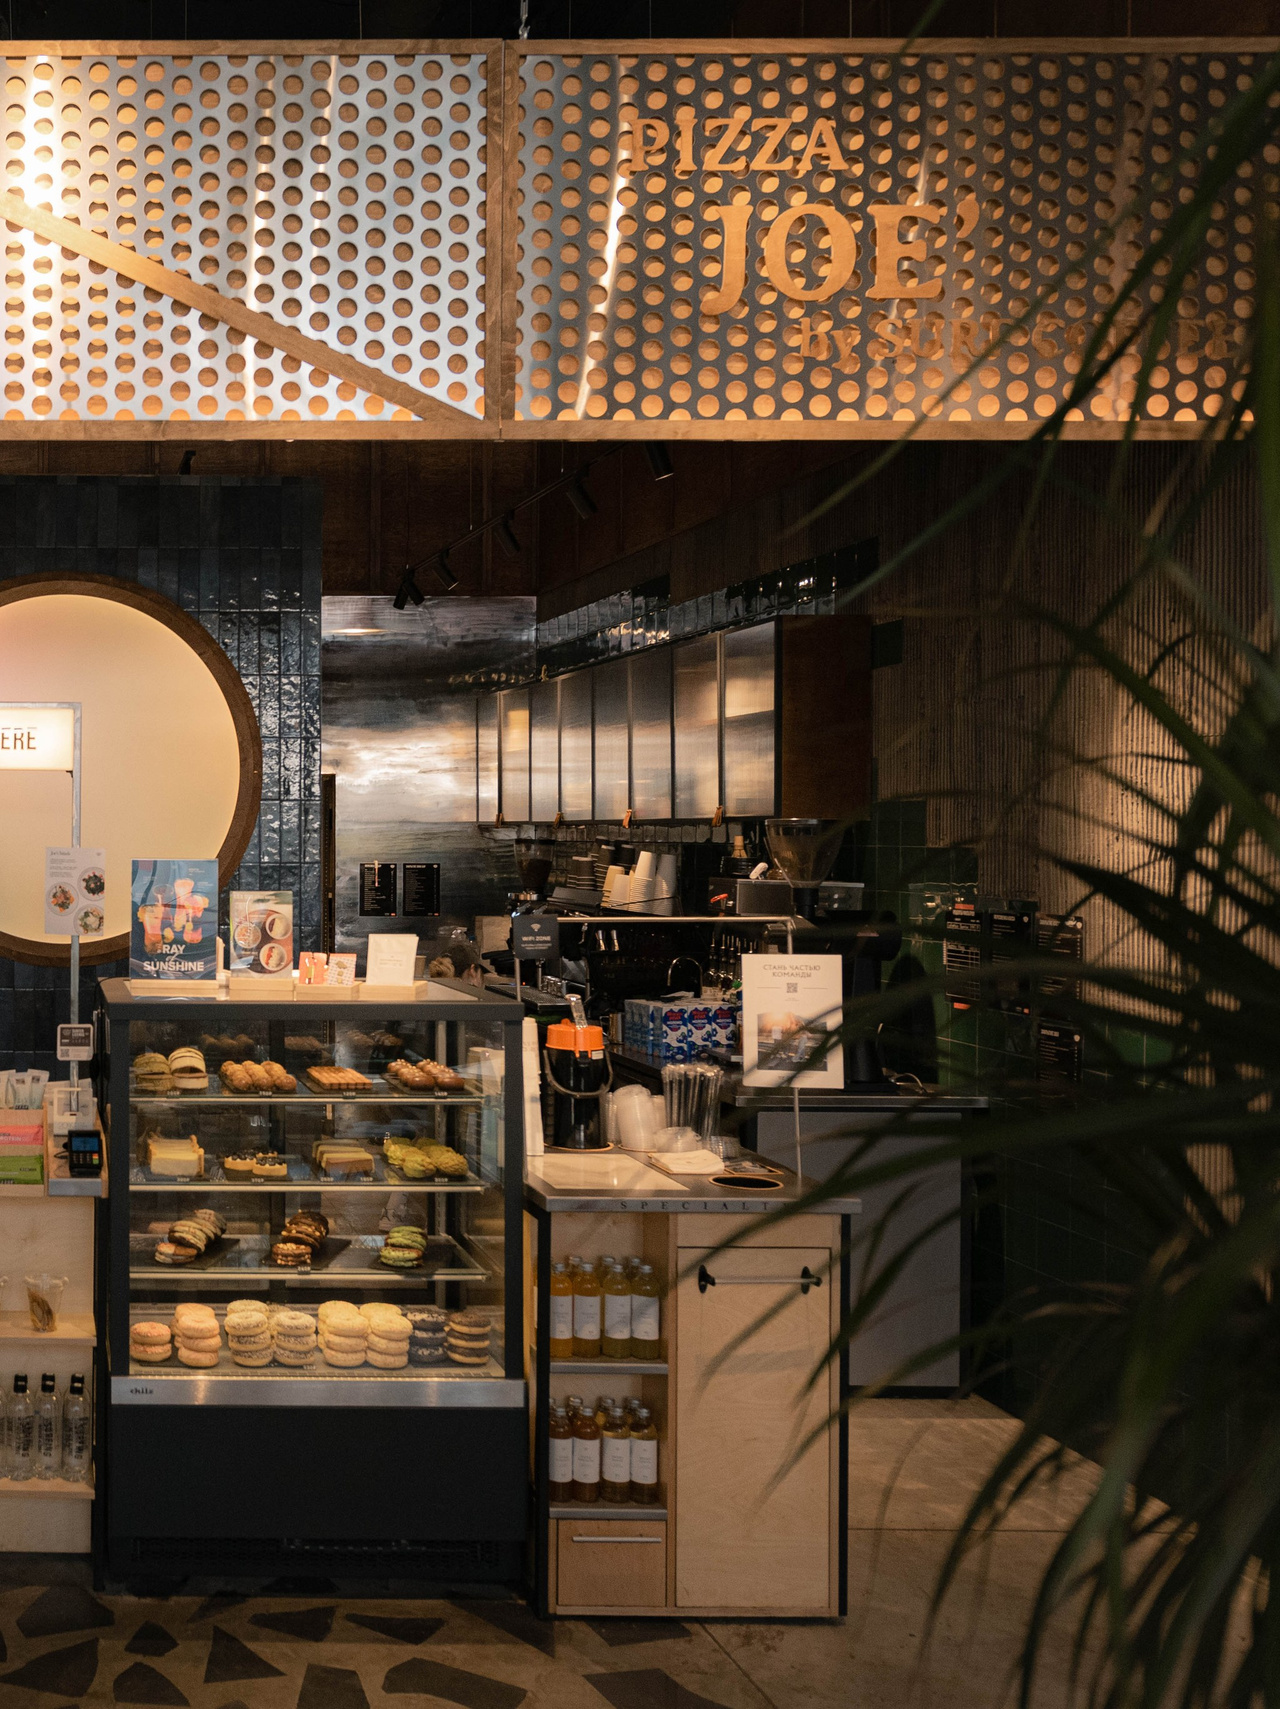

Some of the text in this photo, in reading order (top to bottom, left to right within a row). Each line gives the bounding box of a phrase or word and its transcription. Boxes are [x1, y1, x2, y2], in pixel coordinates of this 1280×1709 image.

[627, 117, 849, 172] PIZZA
[798, 317, 862, 370] by
[162, 944, 186, 954] RAY
[143, 961, 205, 972] SUNSHINE
